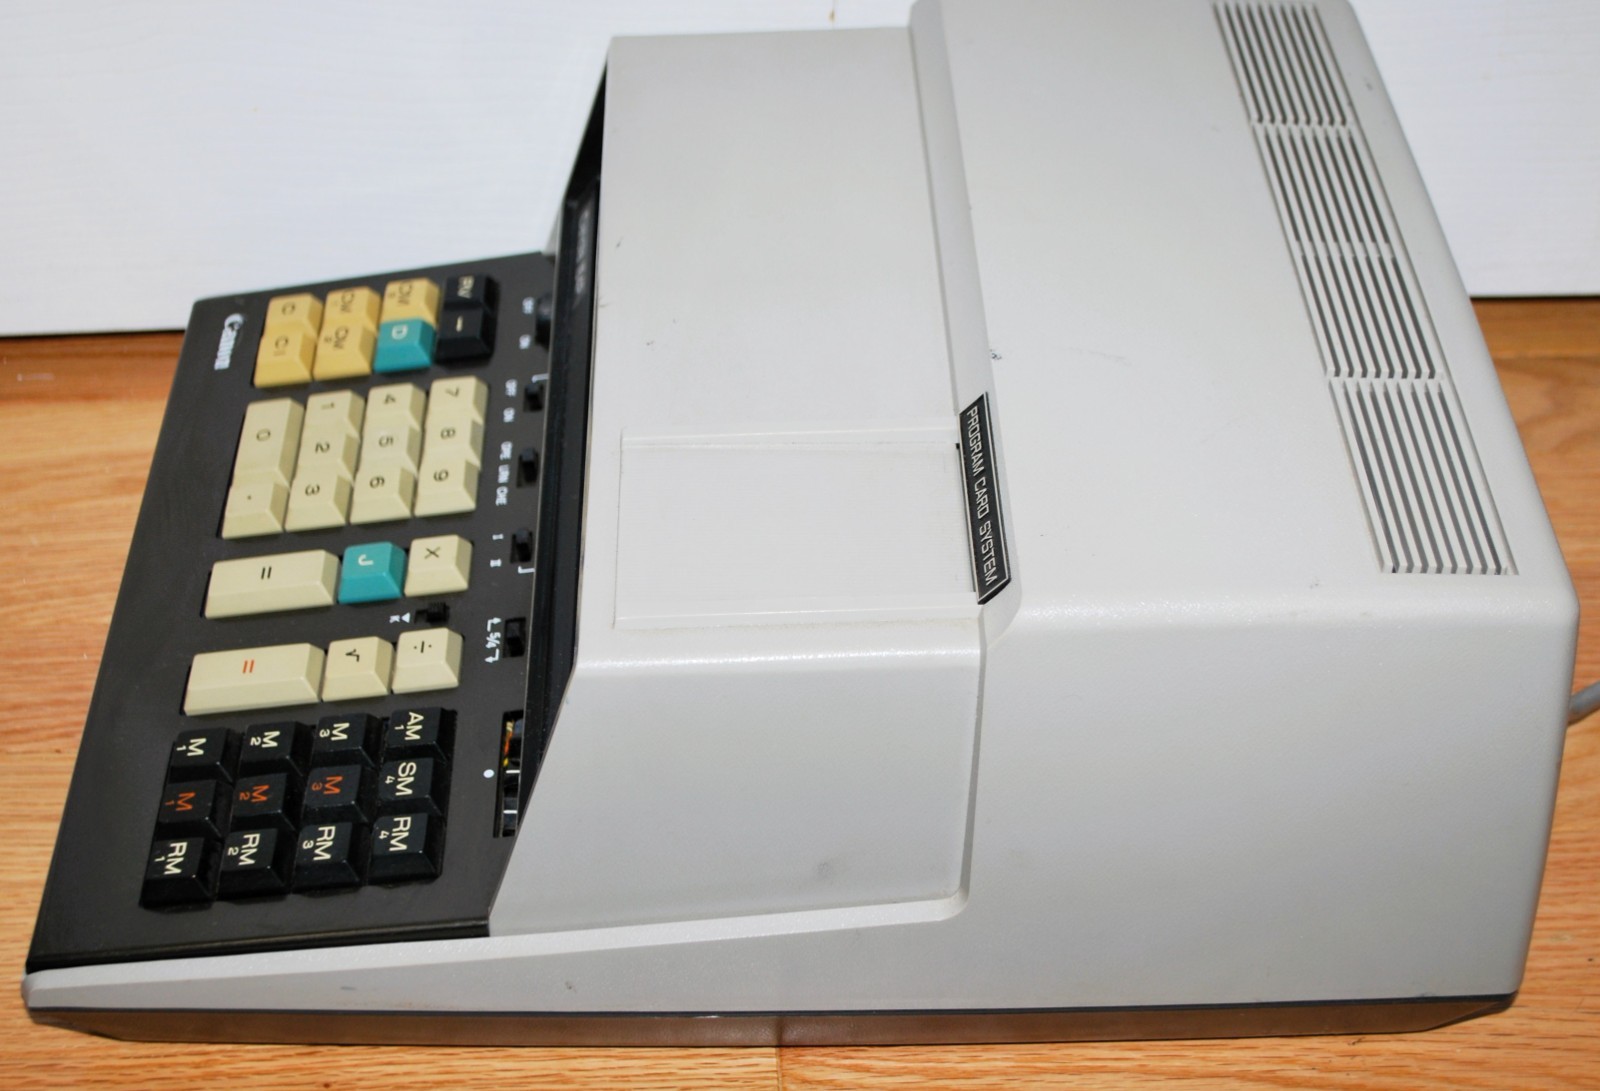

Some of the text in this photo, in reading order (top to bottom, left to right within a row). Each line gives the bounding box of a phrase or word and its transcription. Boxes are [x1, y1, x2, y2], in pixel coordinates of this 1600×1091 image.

[282, 301, 295, 316] C
[391, 324, 407, 340] D
[214, 313, 245, 370] Canon
[445, 386, 460, 397] 7
[383, 393, 397, 405] 4
[503, 379, 517, 423] OFF ON
[321, 402, 335, 410] 1
[256, 428, 271, 442] 0
[440, 427, 456, 440] 8
[315, 441, 330, 454] 2
[379, 435, 394, 447] 5
[369, 475, 385, 488] 6
[433, 469, 449, 482] 9
[305, 483, 320, 496] 3
[966, 406, 998, 586] PROGRAM CARD SYSTEM
[358, 553, 374, 566] J
[389, 614, 400, 623] K
[331, 722, 350, 741] M
[404, 711, 424, 741] AM
[261, 731, 280, 748] M
[319, 728, 331, 738] 3
[187, 737, 207, 756] M
[250, 736, 262, 746] 2
[323, 775, 343, 795] M
[385, 775, 395, 785] 4
[395, 761, 417, 796] SM
[311, 782, 323, 791] 3
[239, 791, 250, 800] 2
[251, 784, 270, 803] M
[176, 791, 196, 811] M
[378, 830, 389, 839] 4
[389, 816, 411, 851] RM
[238, 833, 261, 866] RM
[302, 840, 314, 850] 3
[313, 825, 336, 861] RM
[163, 841, 187, 875] RM
[228, 847, 239, 856] 2
